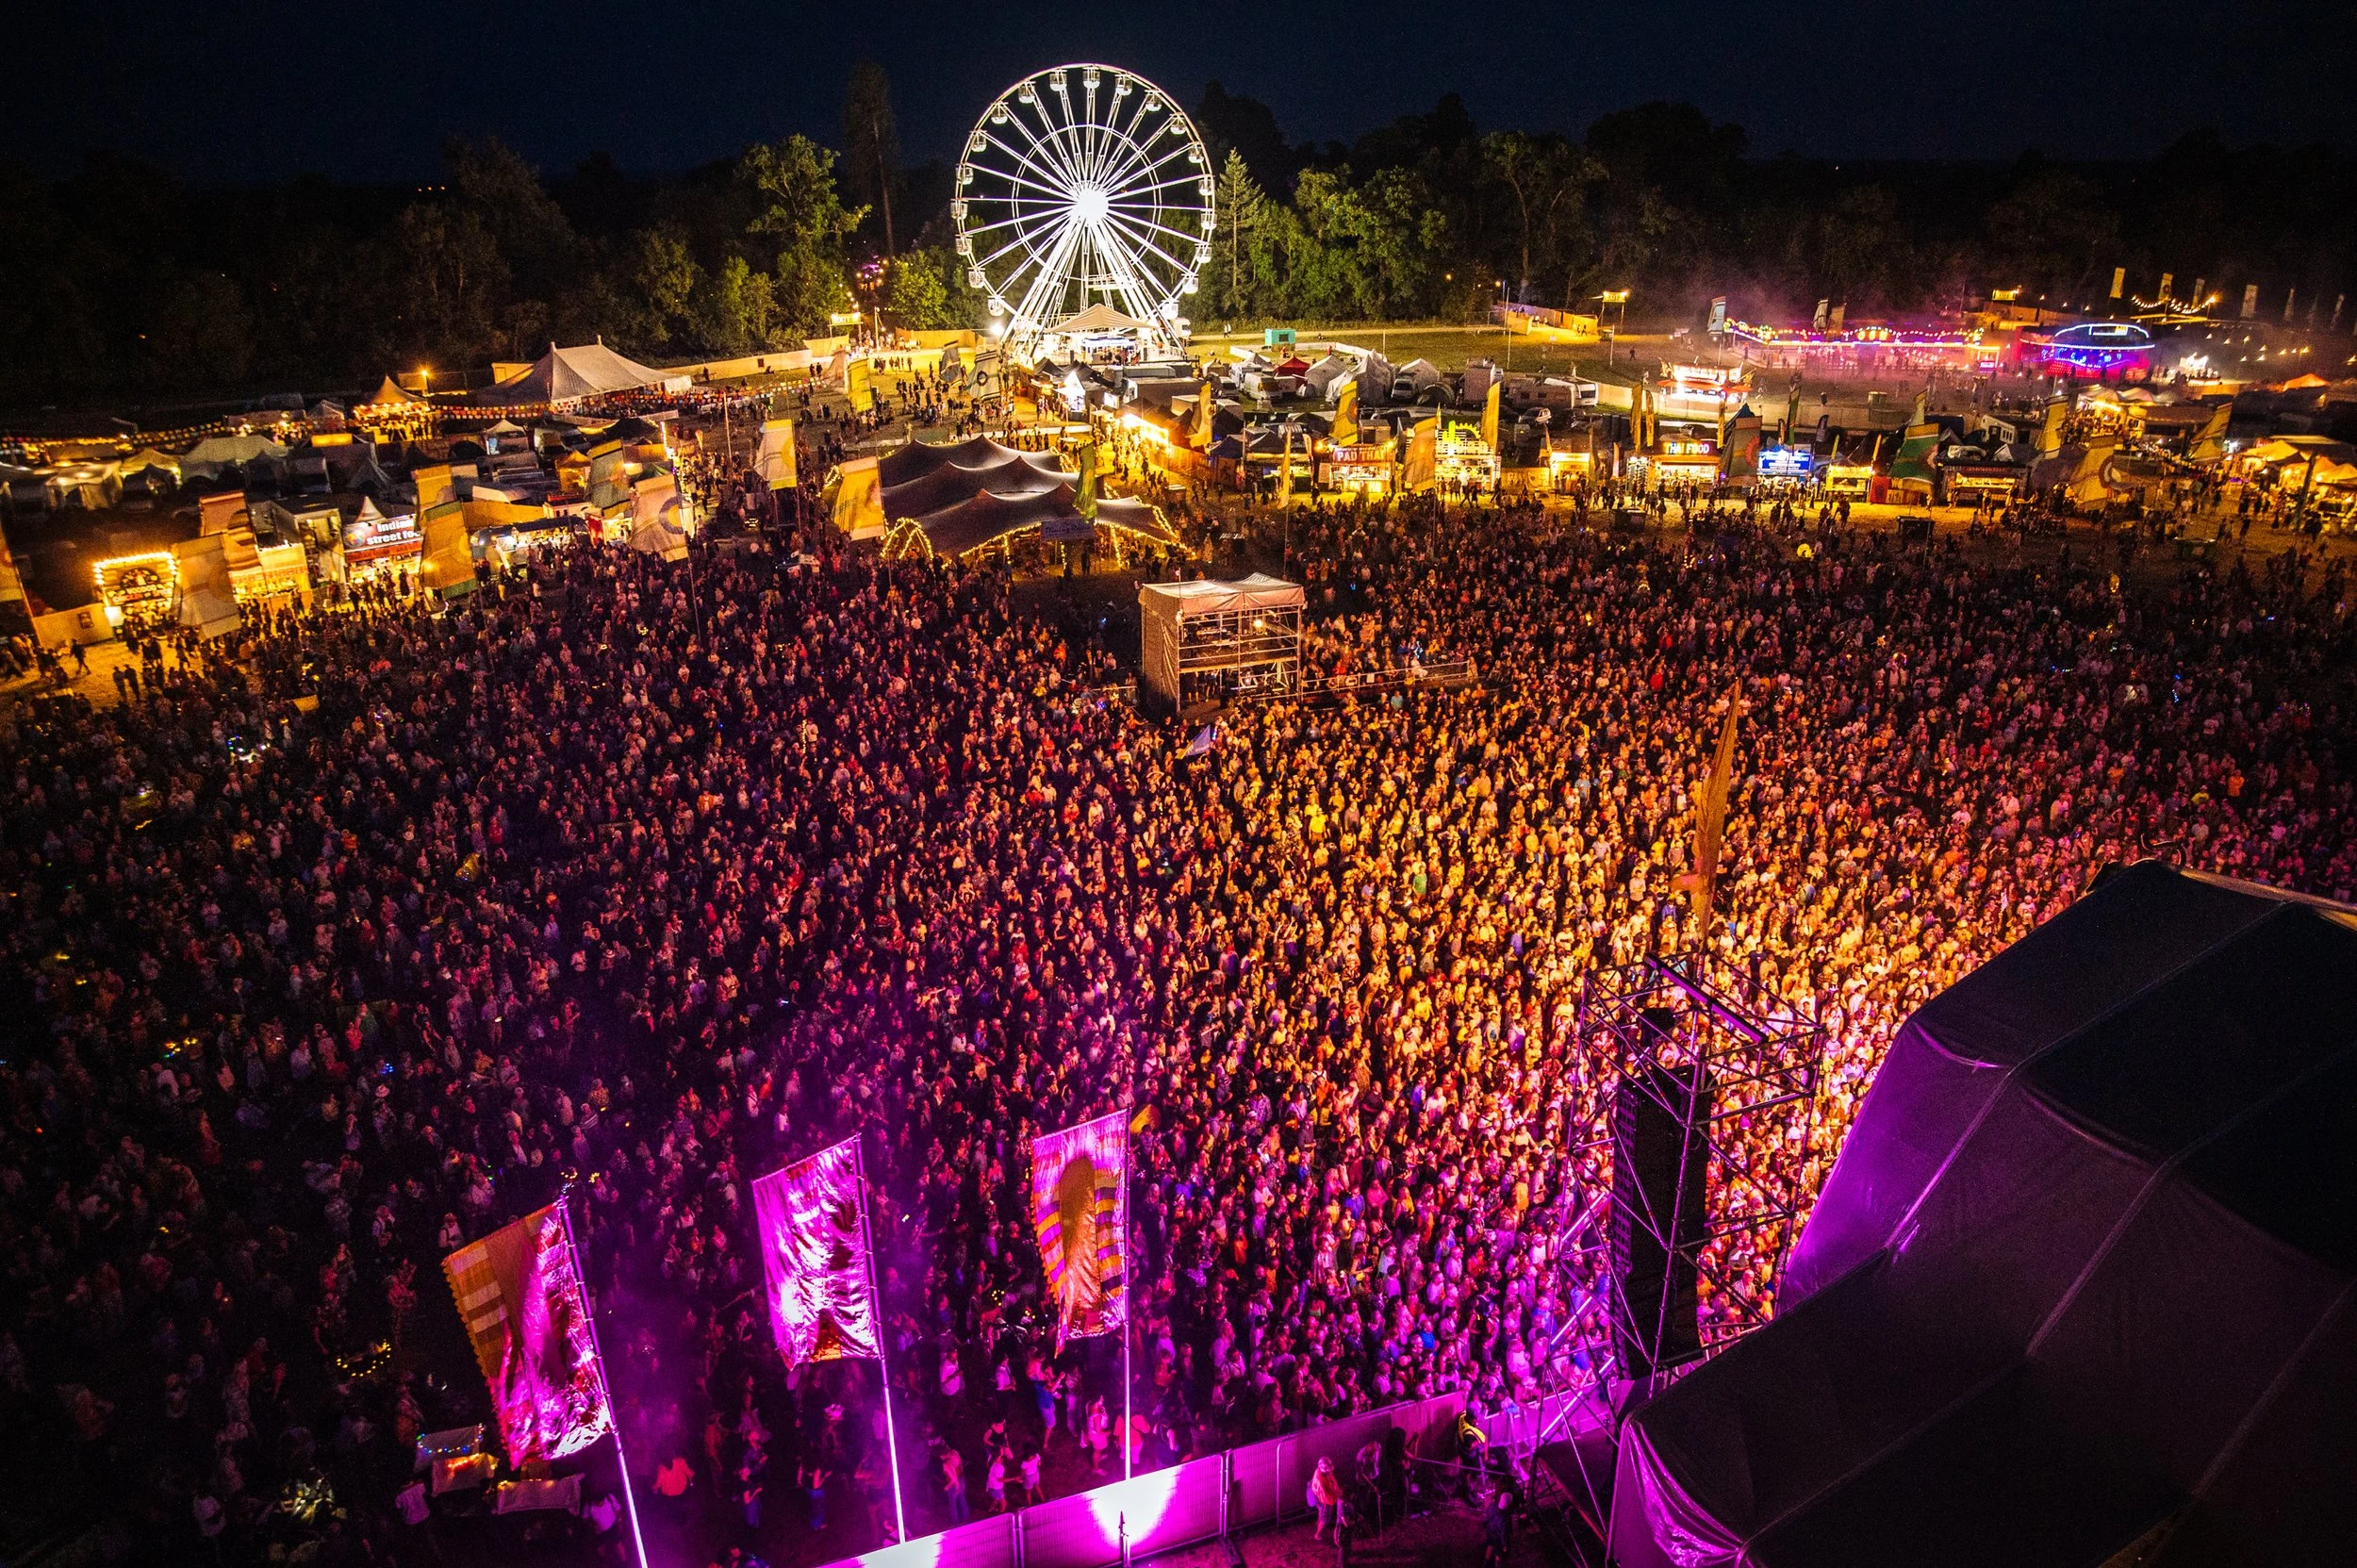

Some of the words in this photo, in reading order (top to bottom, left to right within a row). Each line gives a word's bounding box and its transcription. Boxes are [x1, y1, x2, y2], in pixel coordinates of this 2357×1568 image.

[1664, 442, 1685, 454] THAI
[1686, 443, 1710, 454] FOOD
[1338, 451, 1358, 462] PAD
[1360, 451, 1385, 461] THAI
[378, 520, 415, 532] Indian
[366, 532, 402, 545] street
